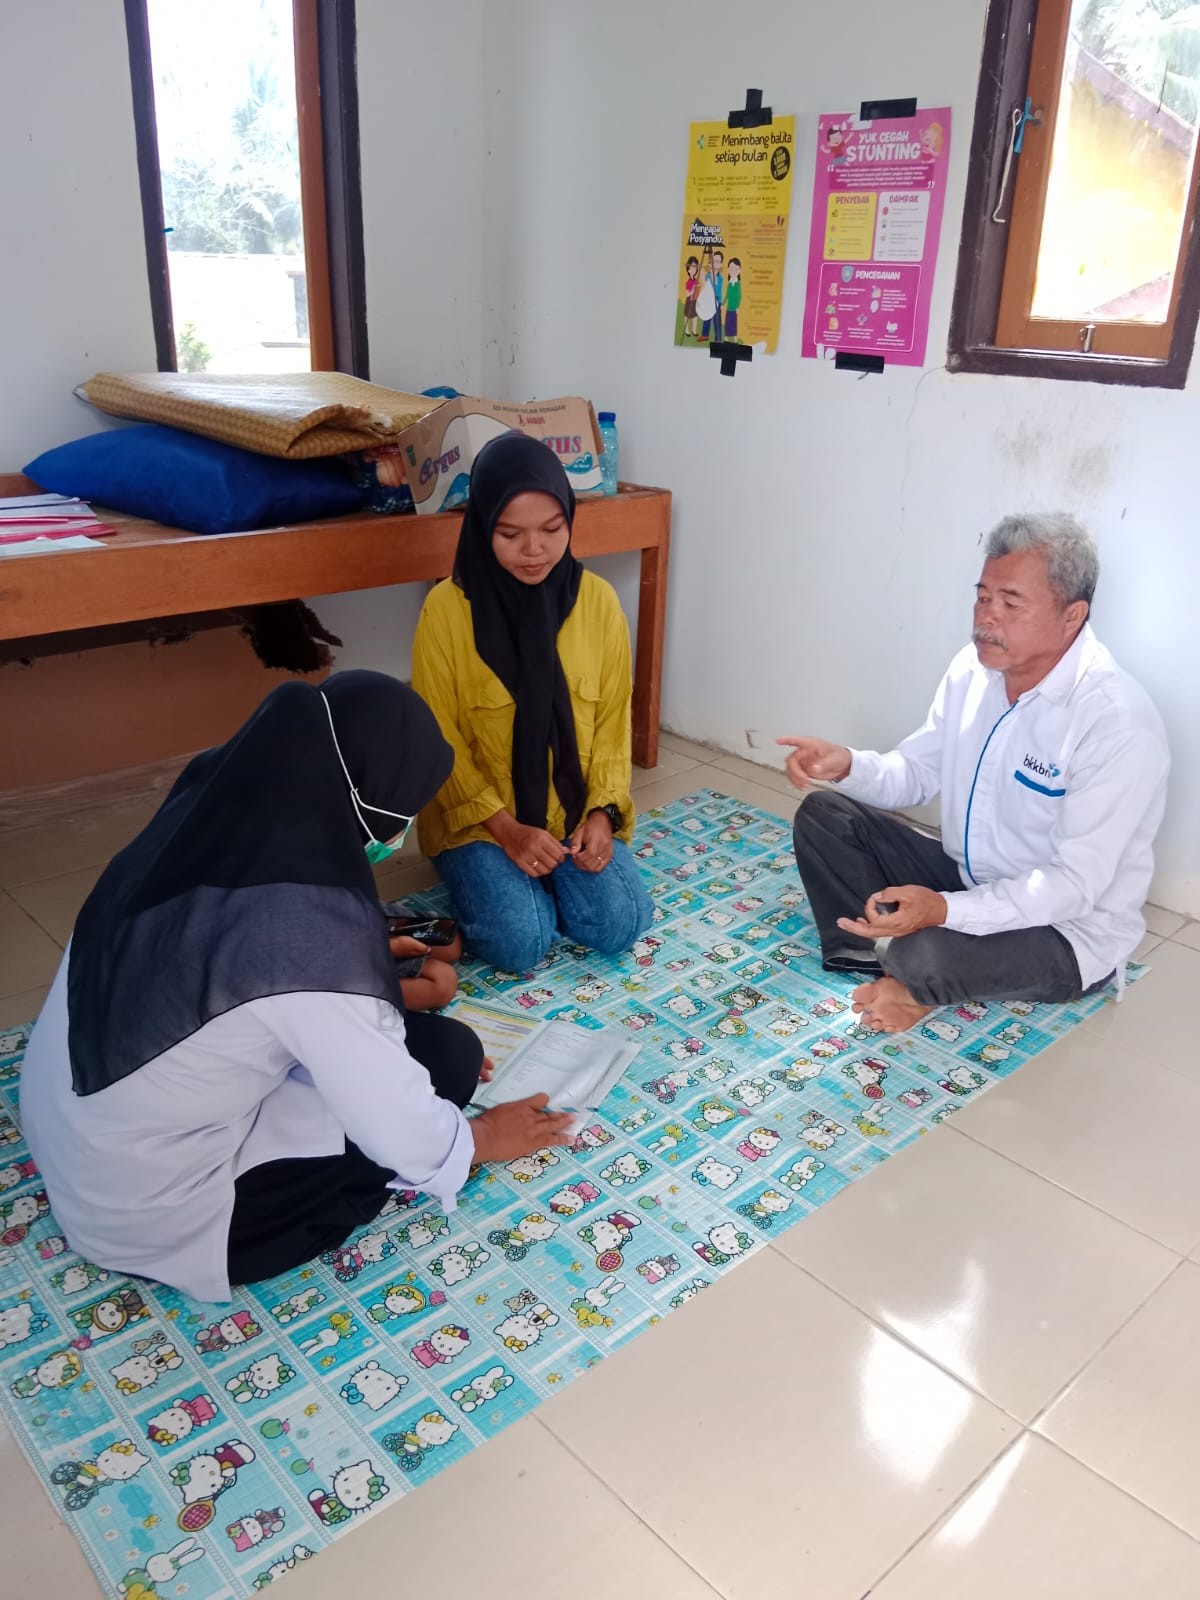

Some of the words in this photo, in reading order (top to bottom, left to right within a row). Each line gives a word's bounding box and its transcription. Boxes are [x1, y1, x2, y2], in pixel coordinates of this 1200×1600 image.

[721, 134, 769, 149] Menimbang
[770, 131, 792, 144] balita
[859, 132, 877, 144] YUK
[880, 131, 909, 142] CEGAH
[715, 150, 740, 166] setiap
[742, 149, 768, 162] bulan
[846, 143, 921, 162] STUNTING
[691, 223, 721, 236] Mengapa
[690, 233, 722, 245] Posyandu
[855, 270, 901, 280] PENCEGAHAN
[1023, 753, 1051, 779] bkkbn
